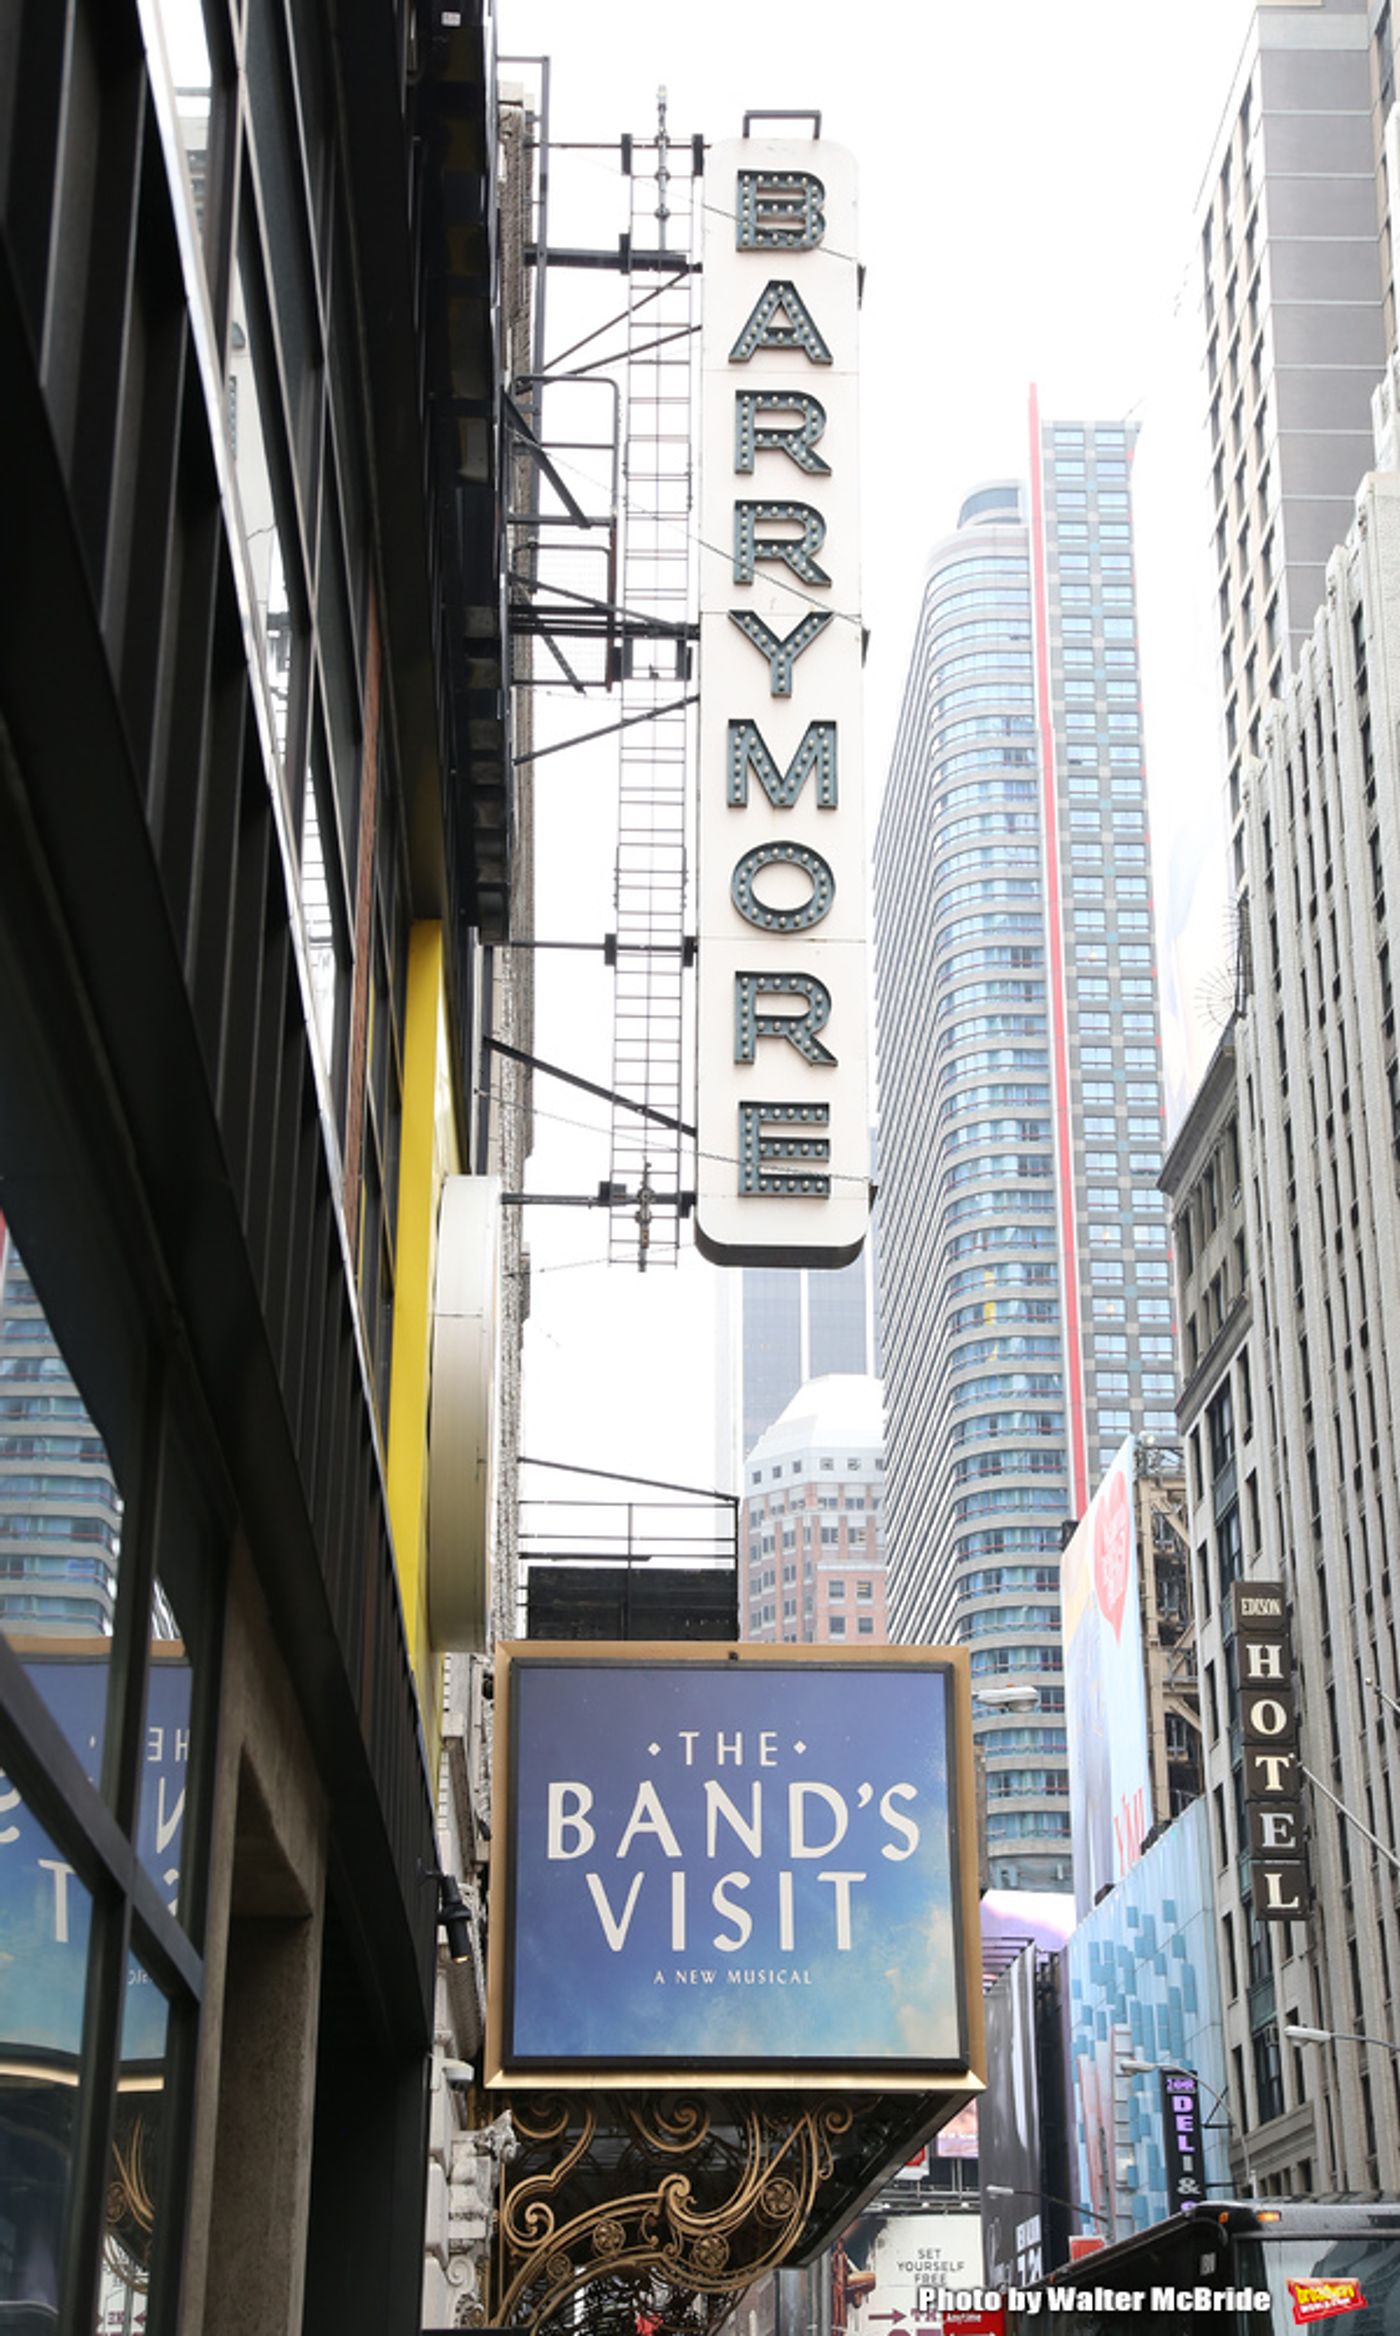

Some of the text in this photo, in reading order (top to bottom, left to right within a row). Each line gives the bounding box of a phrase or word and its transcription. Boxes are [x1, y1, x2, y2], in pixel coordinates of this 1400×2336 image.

[727, 169, 838, 1198] BARRYMORE
[1241, 1597, 1282, 1616] EDISON
[678, 1730, 778, 1766] THE
[1246, 1644, 1299, 1910] HOTEL
[547, 1779, 920, 1862] BAND'S
[586, 1871, 867, 1952] VISIT
[653, 1969, 813, 1985] A NEW MUSICAL
[897, 2261, 965, 2272] YOURSELF
[917, 2248, 942, 2260] SET
[914, 2273, 947, 2285] FREE
